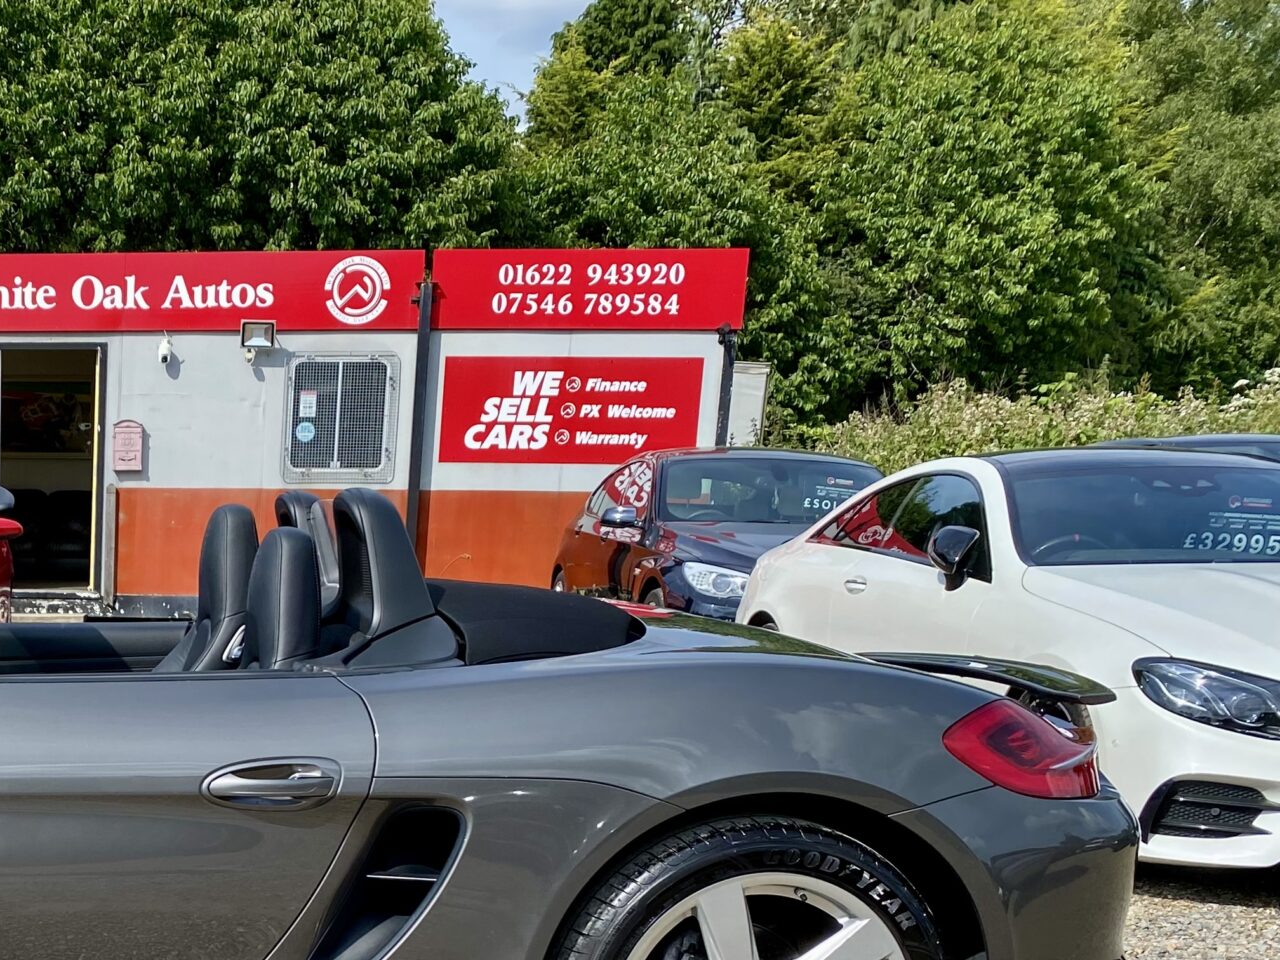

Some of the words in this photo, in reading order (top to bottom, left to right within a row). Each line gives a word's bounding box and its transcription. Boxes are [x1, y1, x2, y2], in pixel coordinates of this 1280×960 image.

[498, 263, 572, 285] 01622
[587, 263, 685, 285] 943920
[72, 274, 150, 310] Oak
[161, 275, 274, 310] Autos
[492, 292, 573, 315] 07546
[584, 293, 680, 316] 789584
[513, 371, 564, 396] WE
[585, 378, 647, 392] Finance
[481, 397, 553, 423] SELL
[579, 404, 602, 418] PX
[607, 404, 676, 418] Welcome
[464, 424, 550, 450] CARS
[575, 432, 648, 448] Warranty
[1183, 532, 1280, 555] £32995
[763, 849, 917, 931] GOODYEAR
